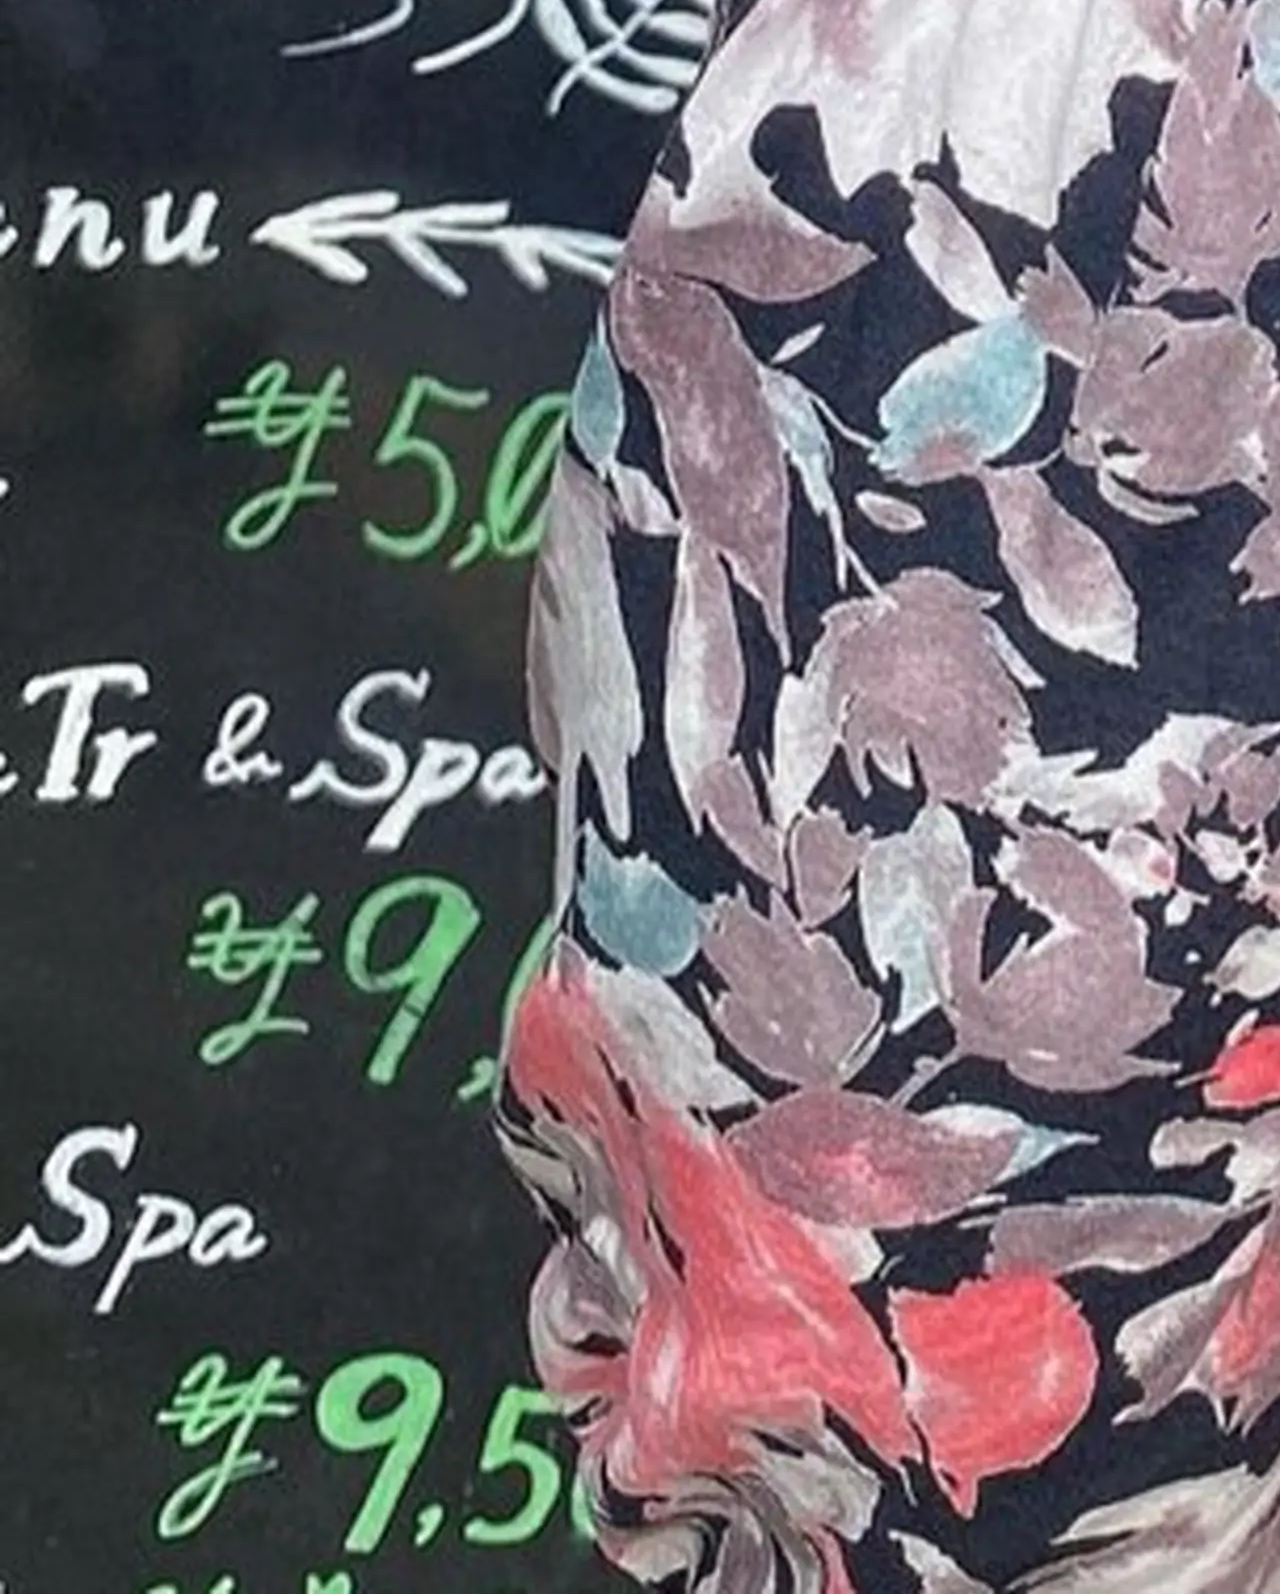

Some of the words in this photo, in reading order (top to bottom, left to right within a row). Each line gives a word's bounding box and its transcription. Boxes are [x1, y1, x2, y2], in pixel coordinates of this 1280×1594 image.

[203, 692, 284, 786] &
[288, 667, 549, 851] Spa
[0, 1123, 268, 1313] Spa
